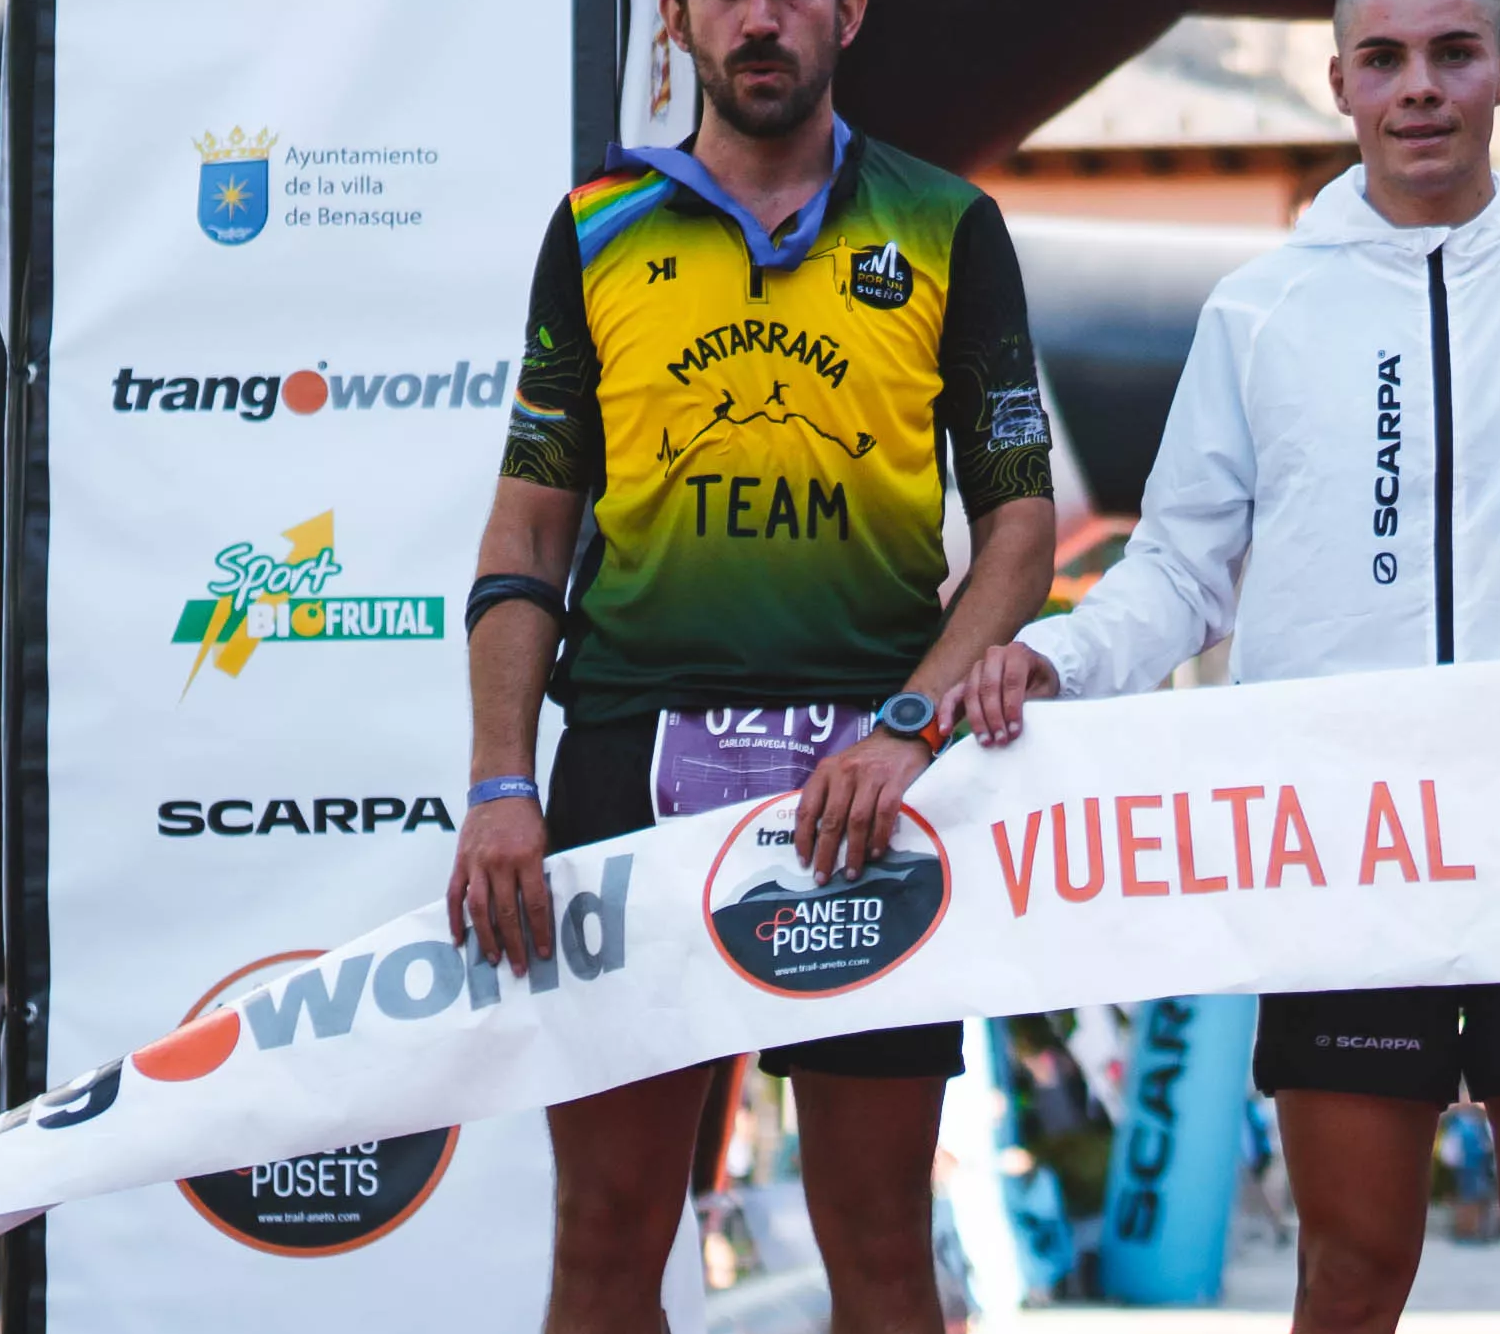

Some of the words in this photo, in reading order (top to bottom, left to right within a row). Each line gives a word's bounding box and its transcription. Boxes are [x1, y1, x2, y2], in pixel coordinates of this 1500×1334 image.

[284, 145, 438, 168] Ayuntamiento
[284, 175, 311, 195] de
[317, 175, 336, 195] la
[341, 175, 383, 195] villa
[284, 206, 311, 226] de
[317, 206, 422, 230] Benasque
[856, 284, 904, 302] SUEÑO
[857, 273, 883, 287] POR
[667, 320, 850, 388] MATARRAÑA
[111, 360, 511, 421] trangoworld
[1373, 354, 1402, 538] SCARPA
[686, 473, 850, 540] TEAM
[206, 542, 342, 611] Sport
[246, 599, 435, 640] BIOFRUTAL
[718, 737, 751, 750] CARLOS
[157, 796, 456, 838] SCARPA
[991, 784, 1328, 920] VUELTA
[1358, 779, 1477, 886] AL
[794, 898, 882, 926] ANETO
[773, 924, 881, 957] POSETS
[1335, 1035, 1421, 1050] SCARPA
[251, 1158, 379, 1198] POSETS
[258, 1209, 360, 1225] www.trail-aneto.com
